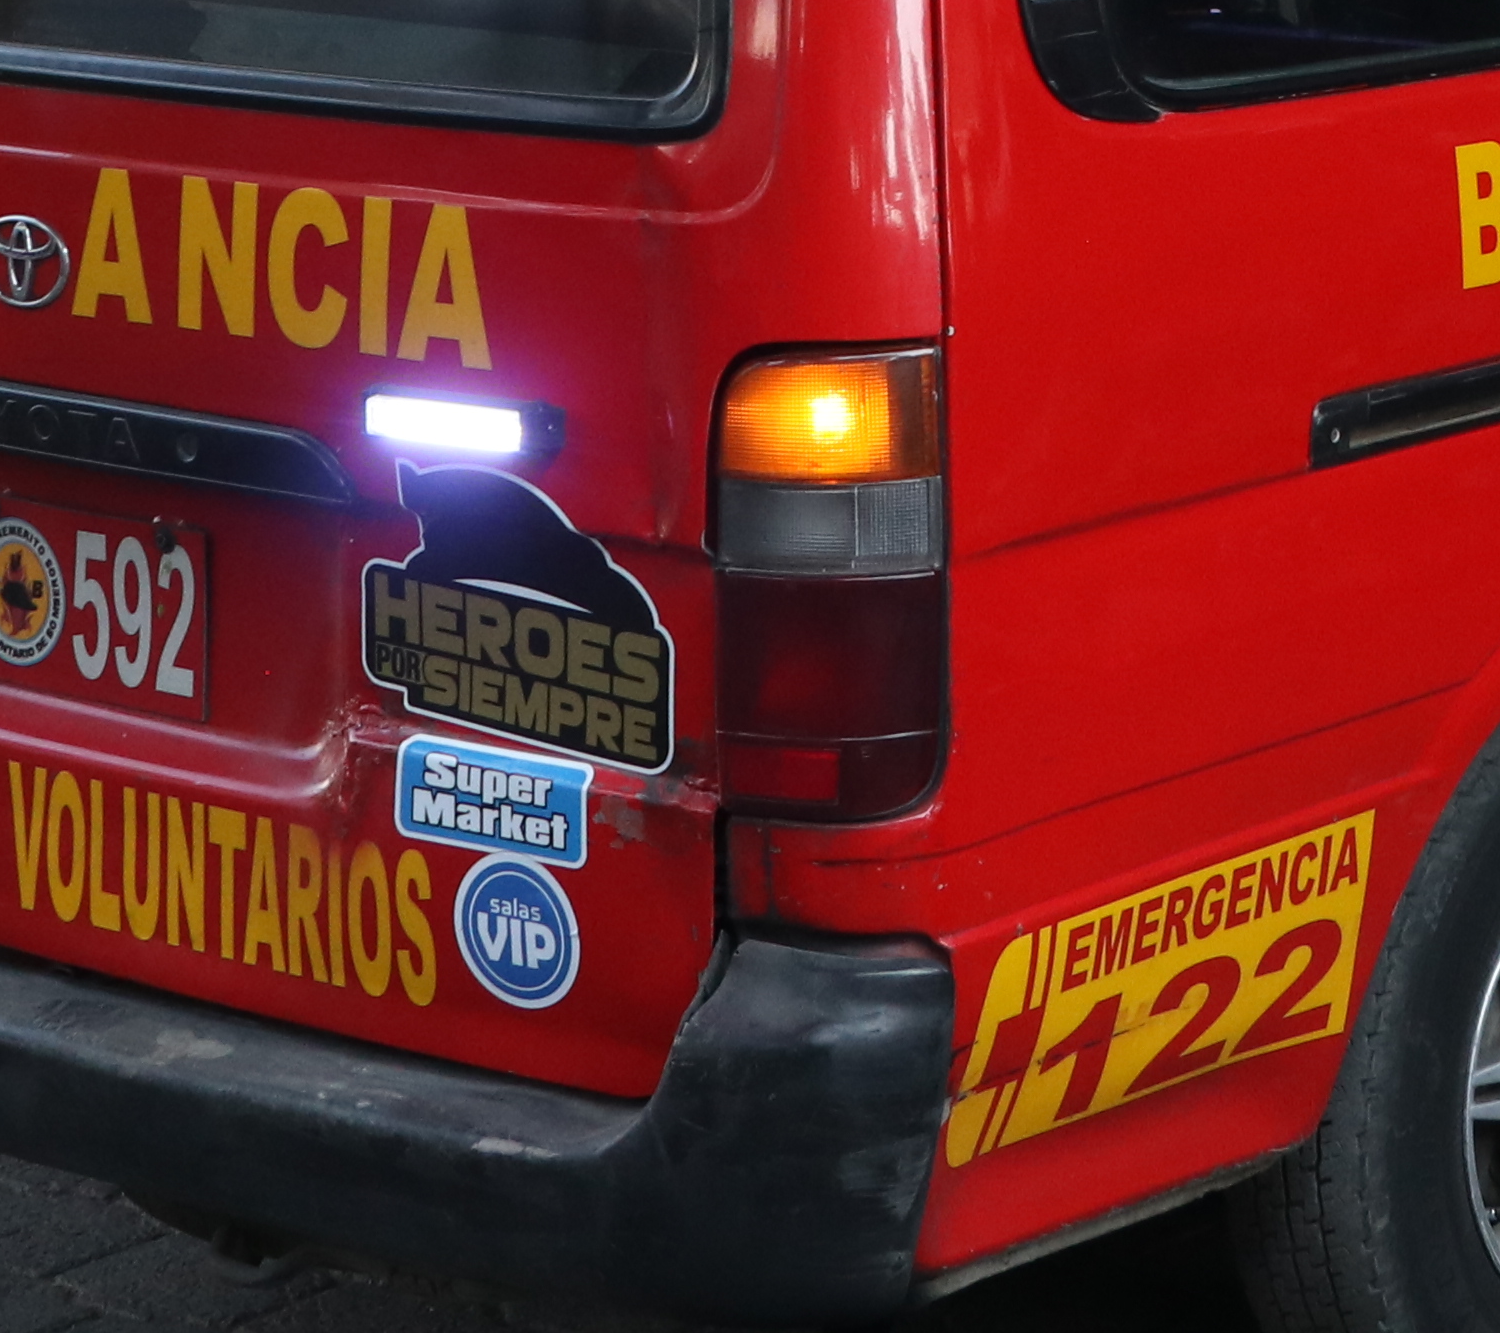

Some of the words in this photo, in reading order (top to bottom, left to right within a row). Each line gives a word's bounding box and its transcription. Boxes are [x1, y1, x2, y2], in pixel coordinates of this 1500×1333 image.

[72, 529, 199, 700] 592
[373, 570, 661, 704] HEROES
[375, 641, 422, 683] POR
[422, 654, 657, 762] SIEMPRE
[411, 787, 569, 851] Market
[424, 751, 553, 808] Super
[8, 759, 437, 1007] VOLUNTARIOS
[476, 911, 557, 970] VIP
[489, 897, 541, 923] salas
[1060, 826, 1359, 993] EMERGENCIA
[1038, 918, 1343, 1123] 122
